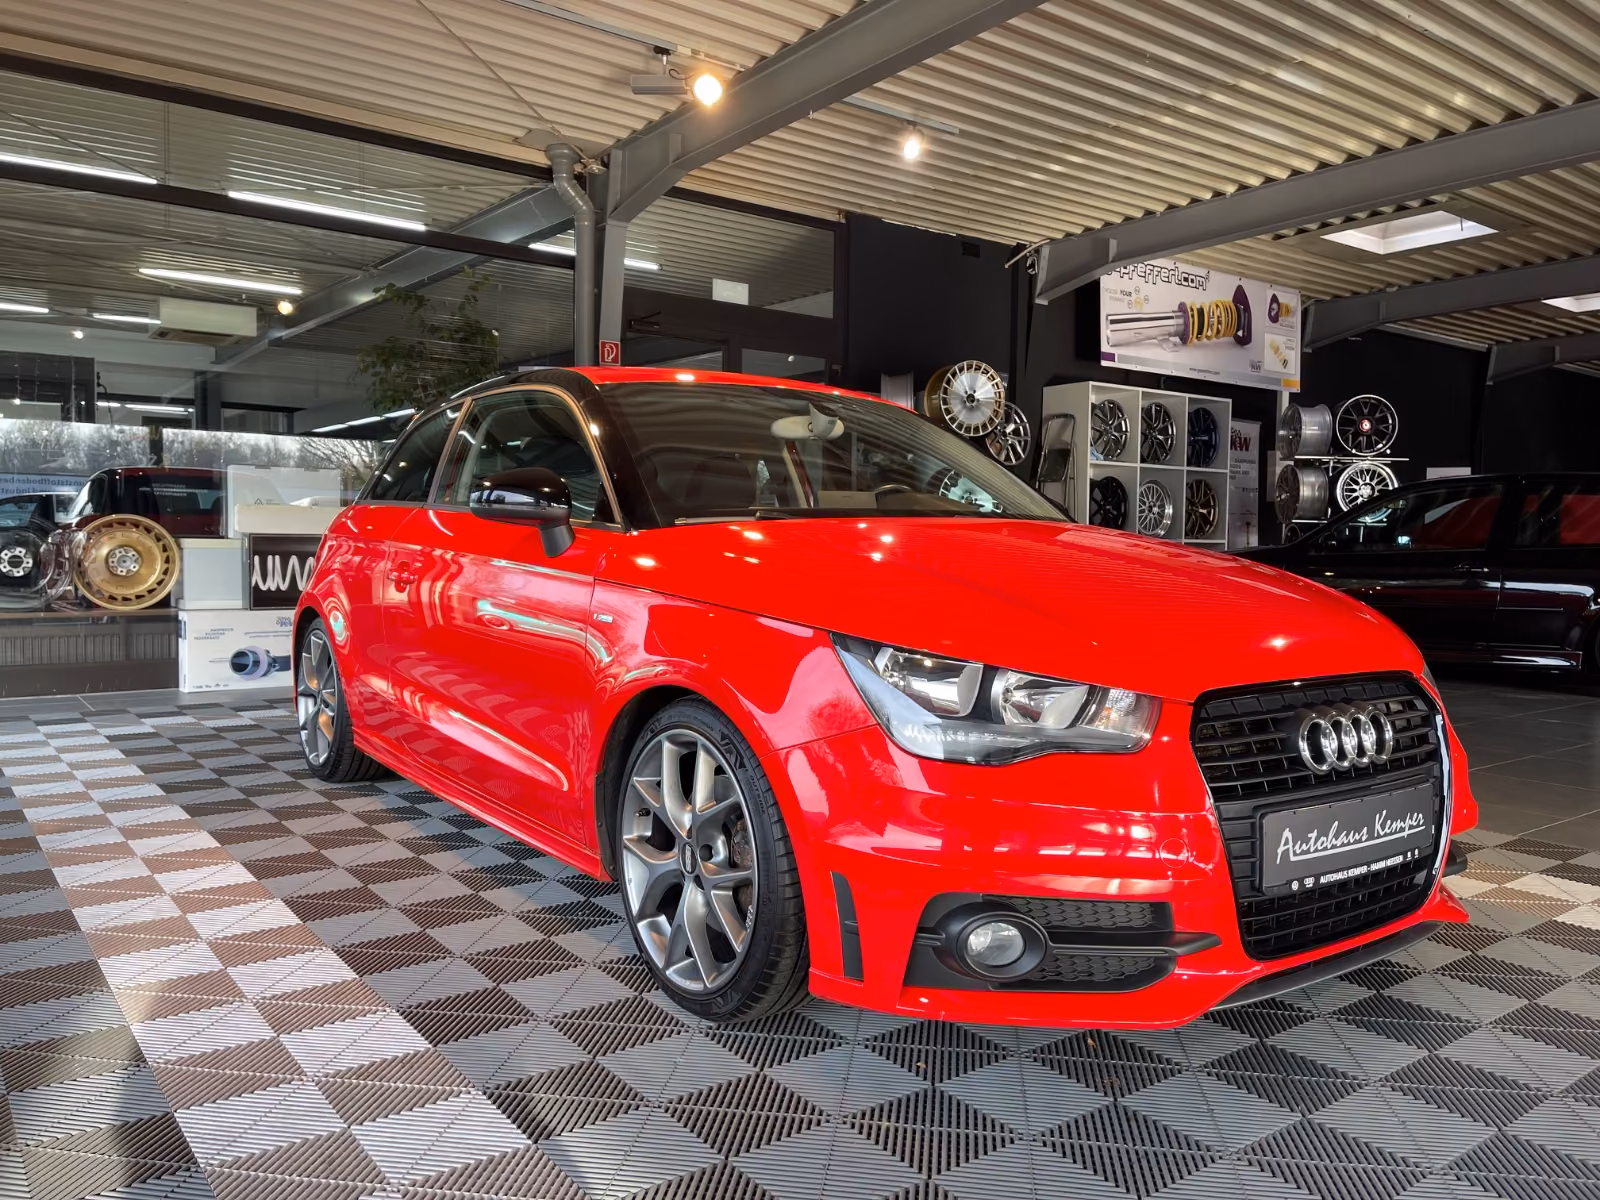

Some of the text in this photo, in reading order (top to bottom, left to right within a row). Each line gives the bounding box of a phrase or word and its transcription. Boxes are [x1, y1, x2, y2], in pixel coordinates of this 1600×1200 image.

[1120, 288, 1133, 297] YOUR
[1276, 809, 1425, 864] Autohaus Kemper
[1319, 870, 1348, 884] AUTOHAUS
[1348, 865, 1368, 878] KEMPER
[1370, 859, 1386, 871] HAMM
